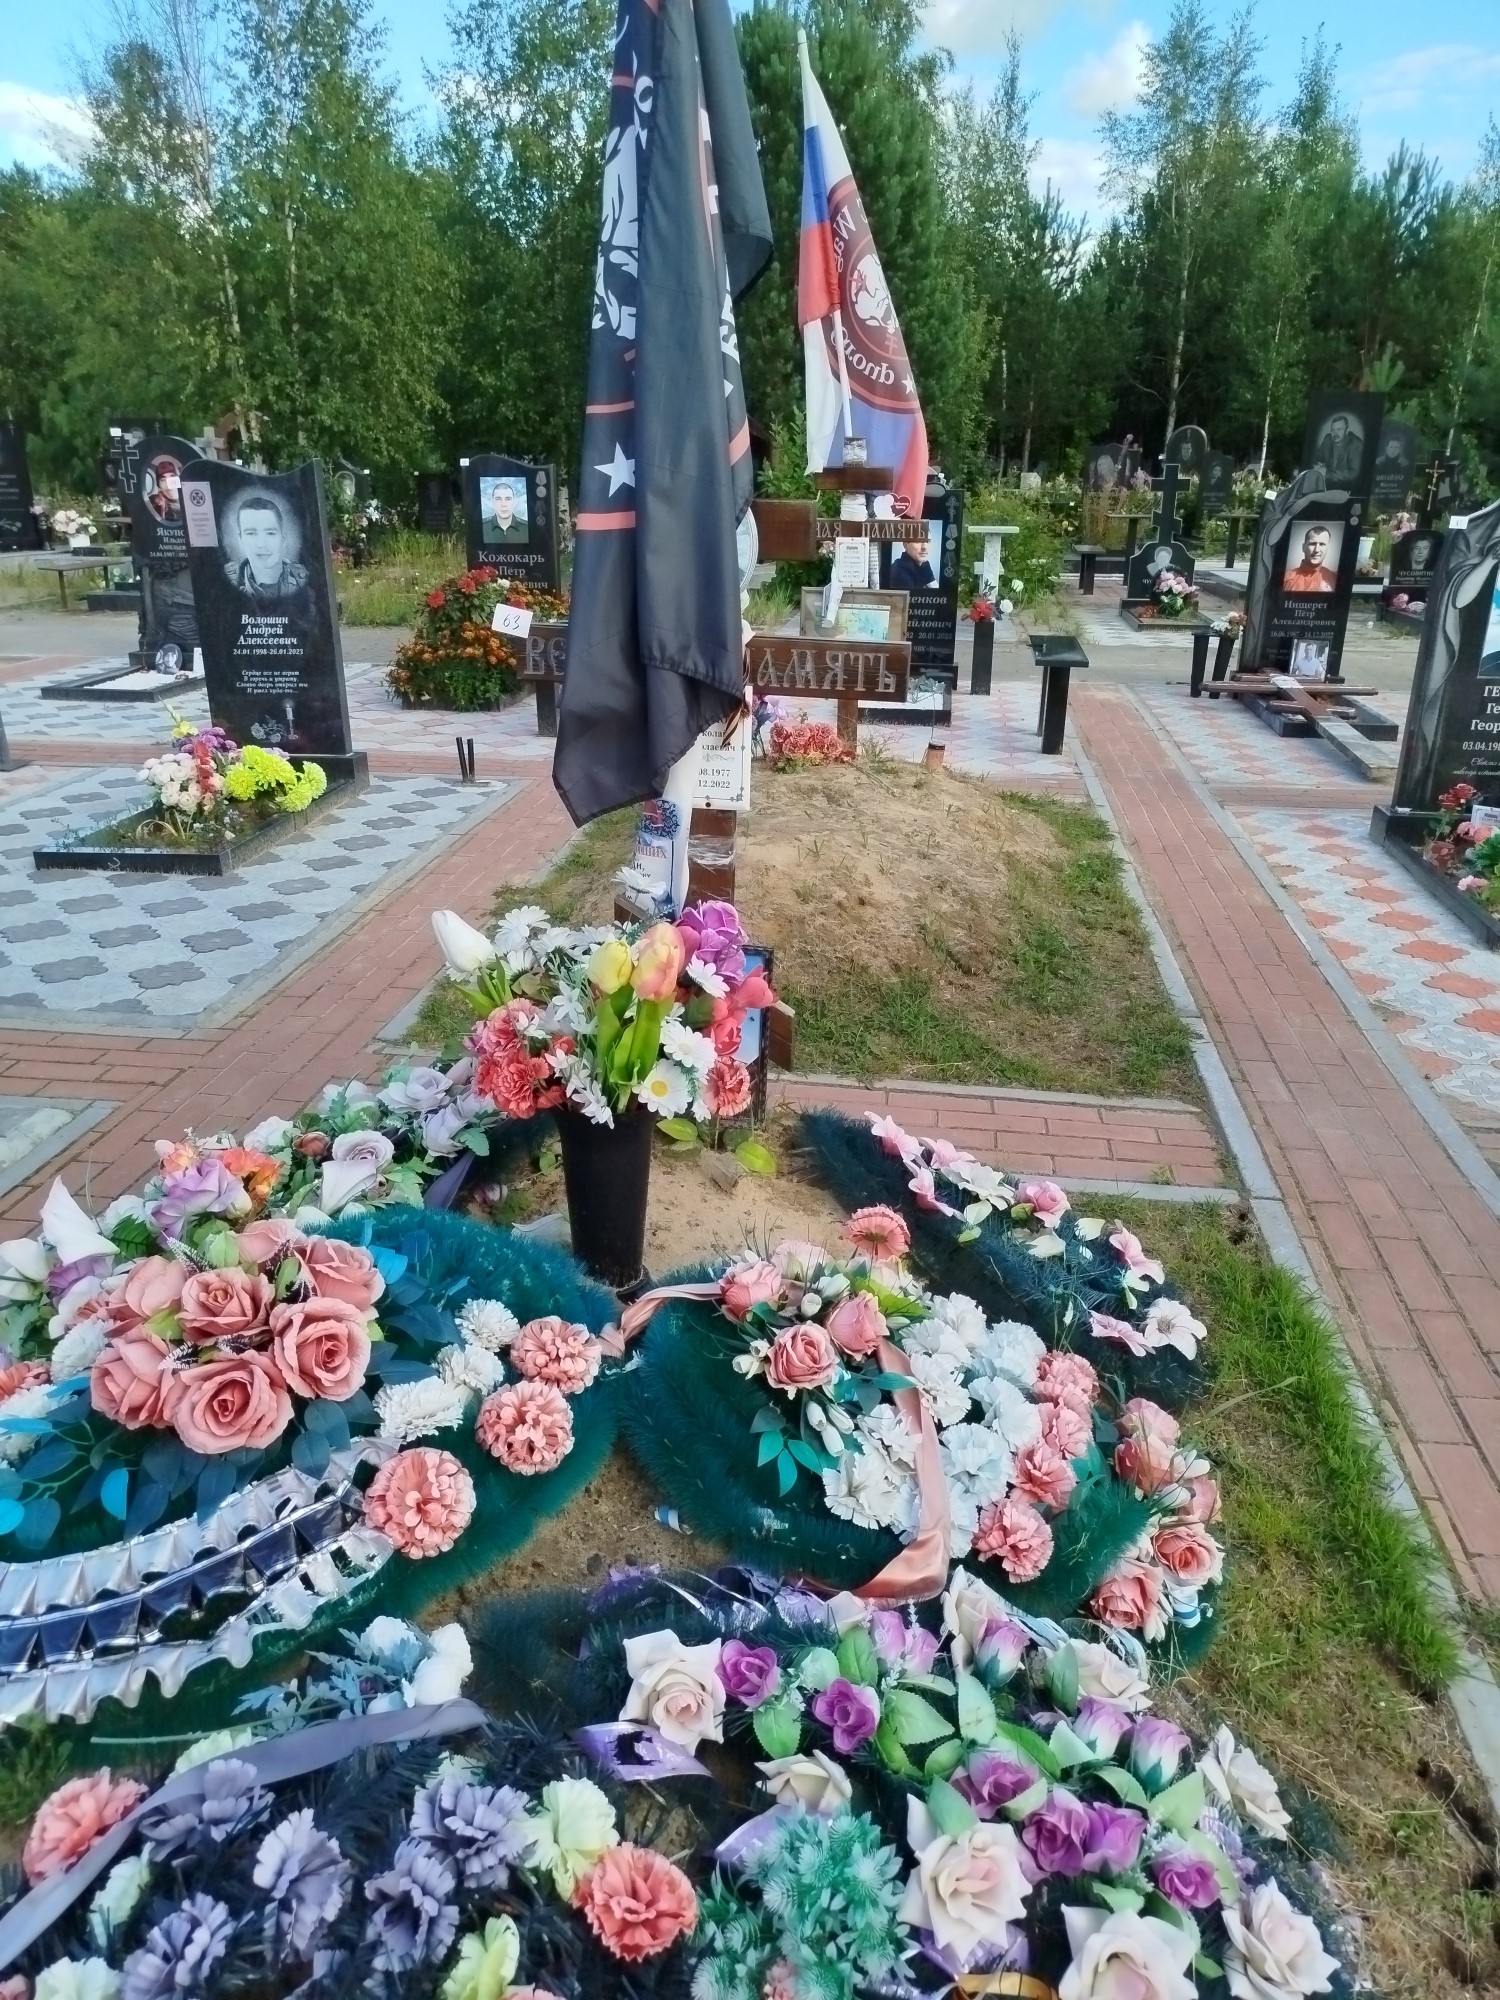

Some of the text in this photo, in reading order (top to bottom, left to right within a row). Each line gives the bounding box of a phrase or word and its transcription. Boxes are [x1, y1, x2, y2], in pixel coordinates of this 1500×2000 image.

[862, 522, 926, 538] ПАМЯТЬ
[478, 550, 544, 566] Кожокарь
[499, 566, 525, 578] Пётр
[1284, 600, 1328, 610] Нищерет
[241, 614, 288, 624] Волошин
[1294, 609, 1315, 618] Пётр
[503, 614, 520, 630] 63
[907, 618, 952, 628] айлович
[1272, 618, 1335, 627] Александрович
[245, 624, 283, 636] Андрей
[237, 635, 298, 644] Алексеевич
[524, 636, 896, 692] ВЕ АМЯТЬ
